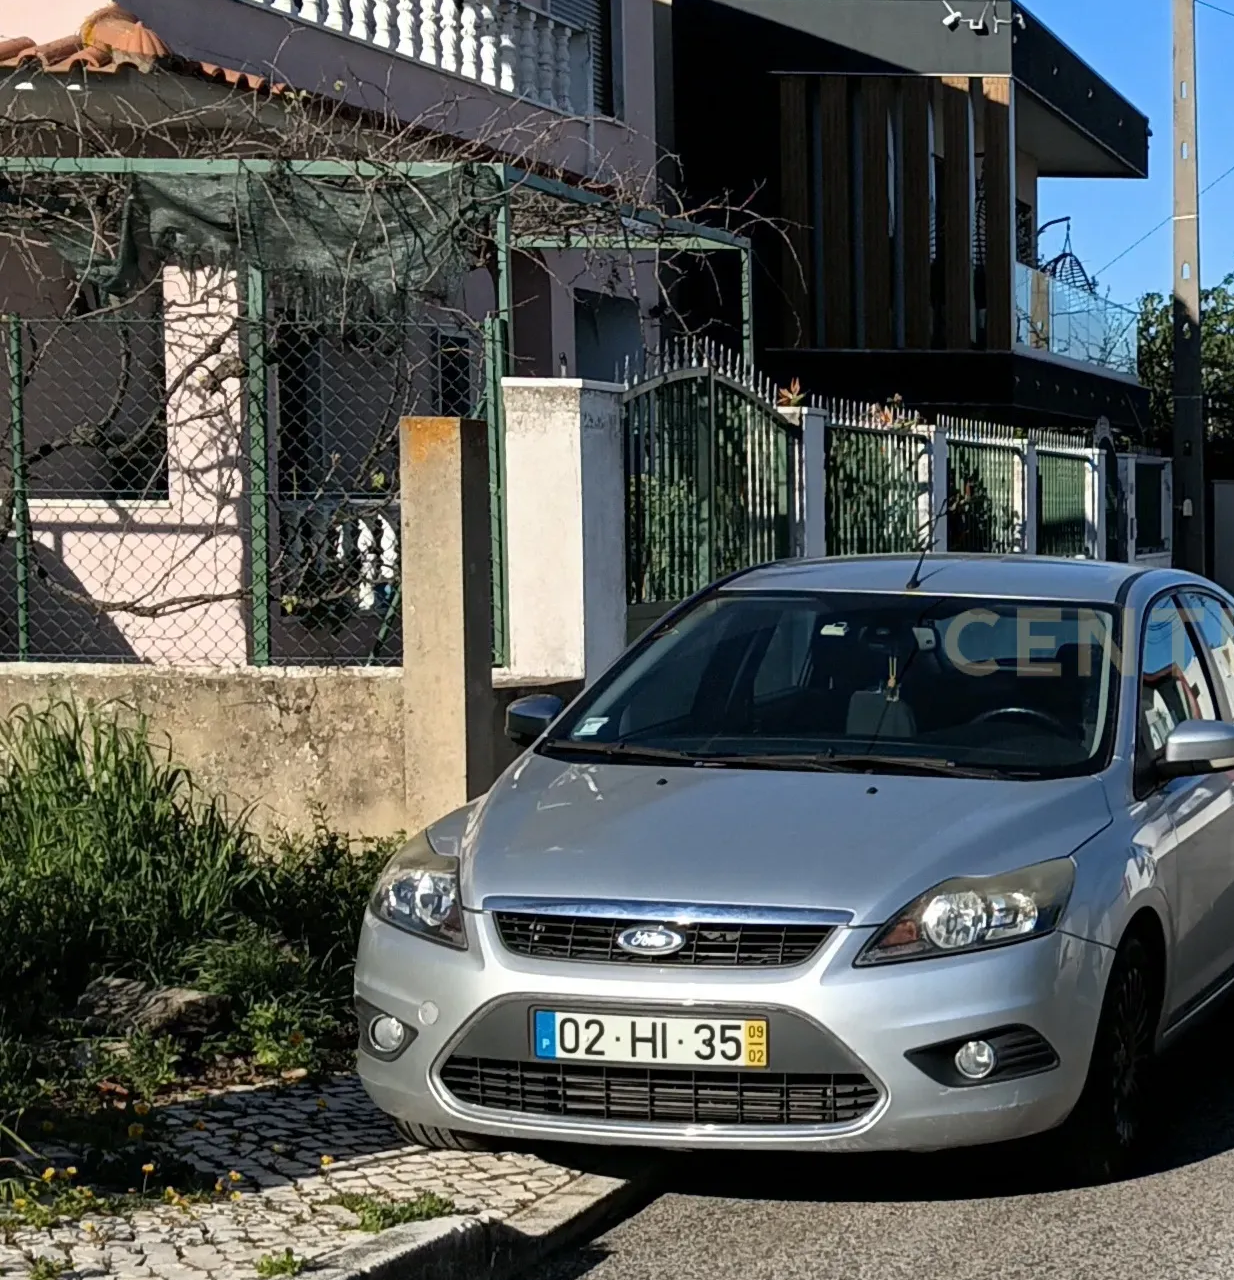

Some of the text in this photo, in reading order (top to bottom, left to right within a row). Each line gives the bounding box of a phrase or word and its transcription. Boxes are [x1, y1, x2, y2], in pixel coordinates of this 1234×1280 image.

[748, 1025, 764, 1039] 09
[541, 1038, 550, 1050] P
[748, 1049, 764, 1063] 02
